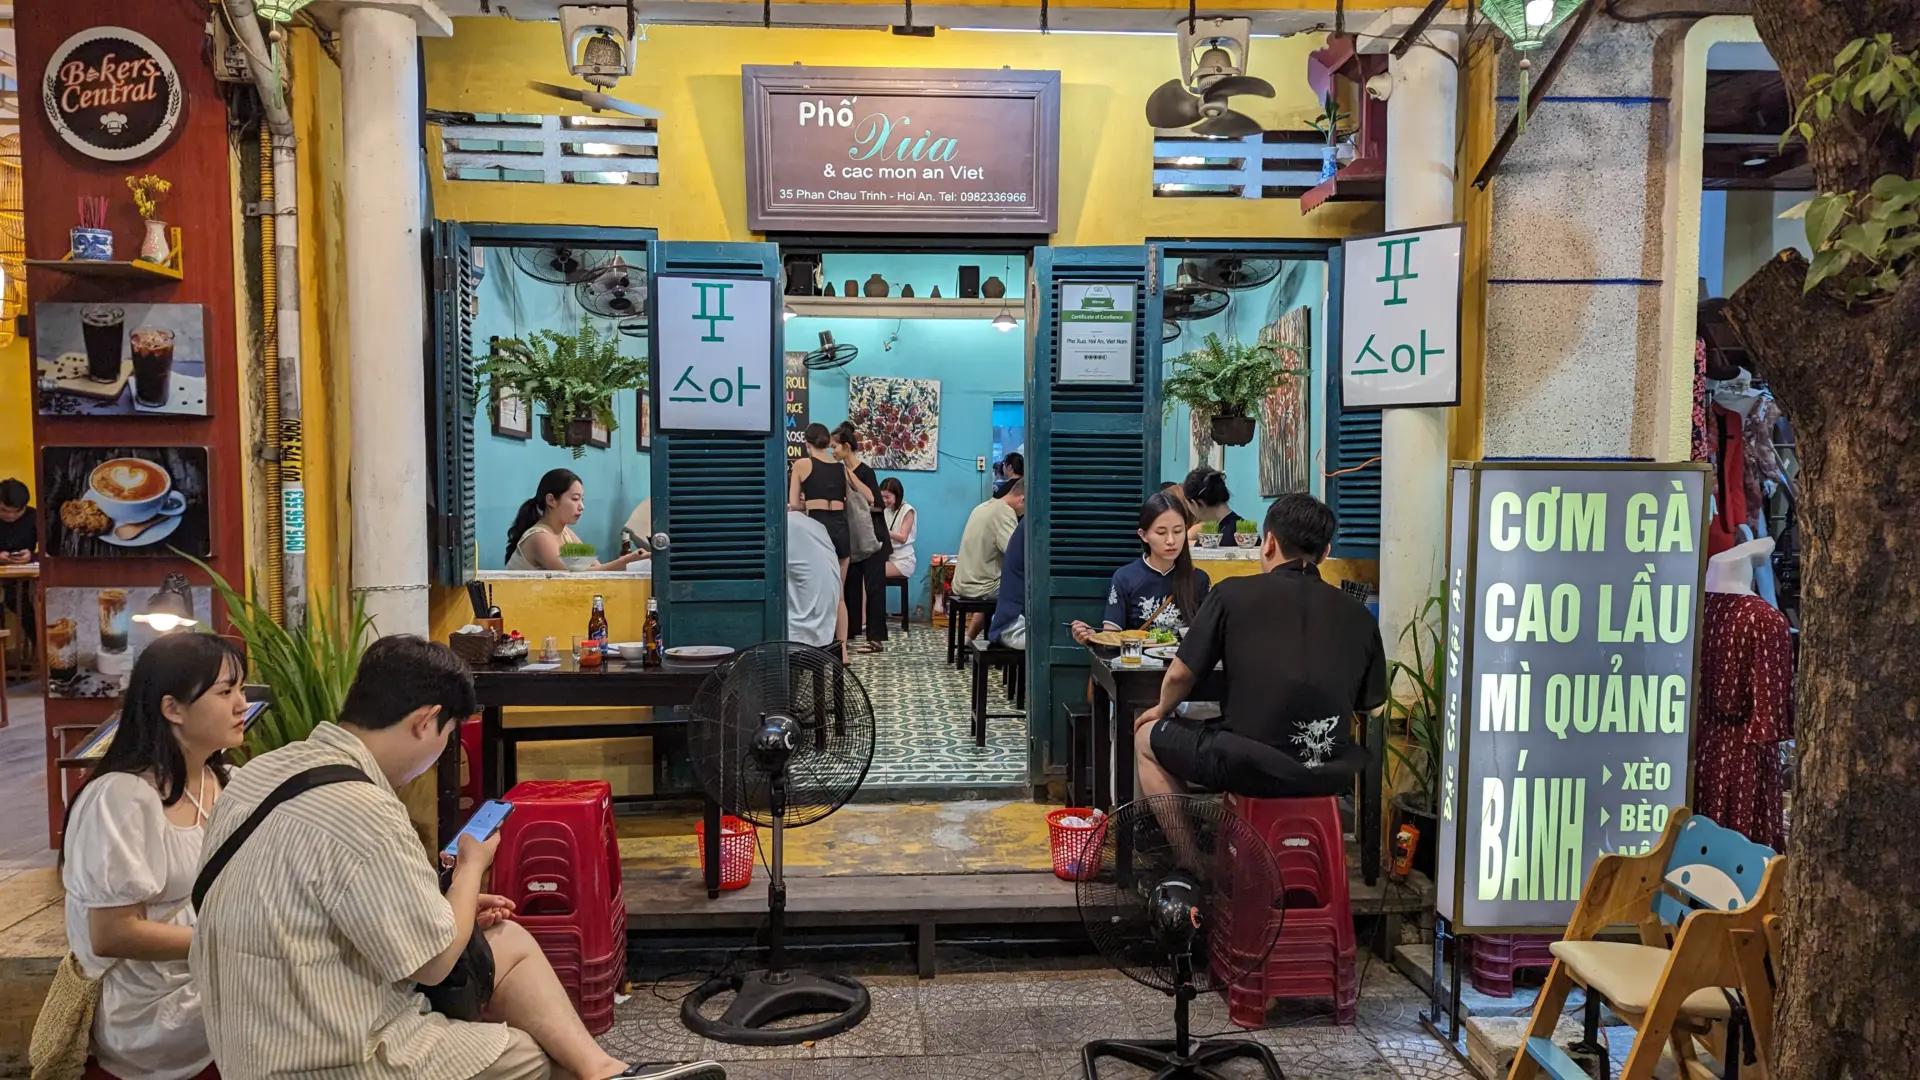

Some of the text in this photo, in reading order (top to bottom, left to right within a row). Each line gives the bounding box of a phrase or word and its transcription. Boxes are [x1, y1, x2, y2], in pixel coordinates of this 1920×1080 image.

[61, 73, 160, 113] Central
[799, 96, 857, 127] Phố
[823, 163, 984, 180] & cac mon an Viet
[779, 189, 793, 199] 35
[796, 189, 825, 200] Phan
[827, 189, 857, 200] Chau
[859, 190, 887, 201] Trinh
[897, 191, 915, 201] Hoi
[918, 191, 935, 202] An.
[938, 191, 957, 202] Tel:
[960, 192, 1027, 202] 0982336966
[1375, 236, 1420, 306] 포
[691, 282, 734, 342] 포
[1350, 329, 1445, 376] 스아
[668, 365, 761, 407] 스아
[284, 491, 305, 552] 0915 456 553
[1489, 480, 1694, 553] CƠM GÀ
[1453, 568, 1462, 613] An
[1484, 563, 1691, 644] CAO LẦU
[1479, 653, 1686, 740] MÌ QUẢNG
[1621, 756, 1671, 790] XÈO
[1478, 749, 1586, 901] BÁNH
[1620, 798, 1668, 832] BÈO
